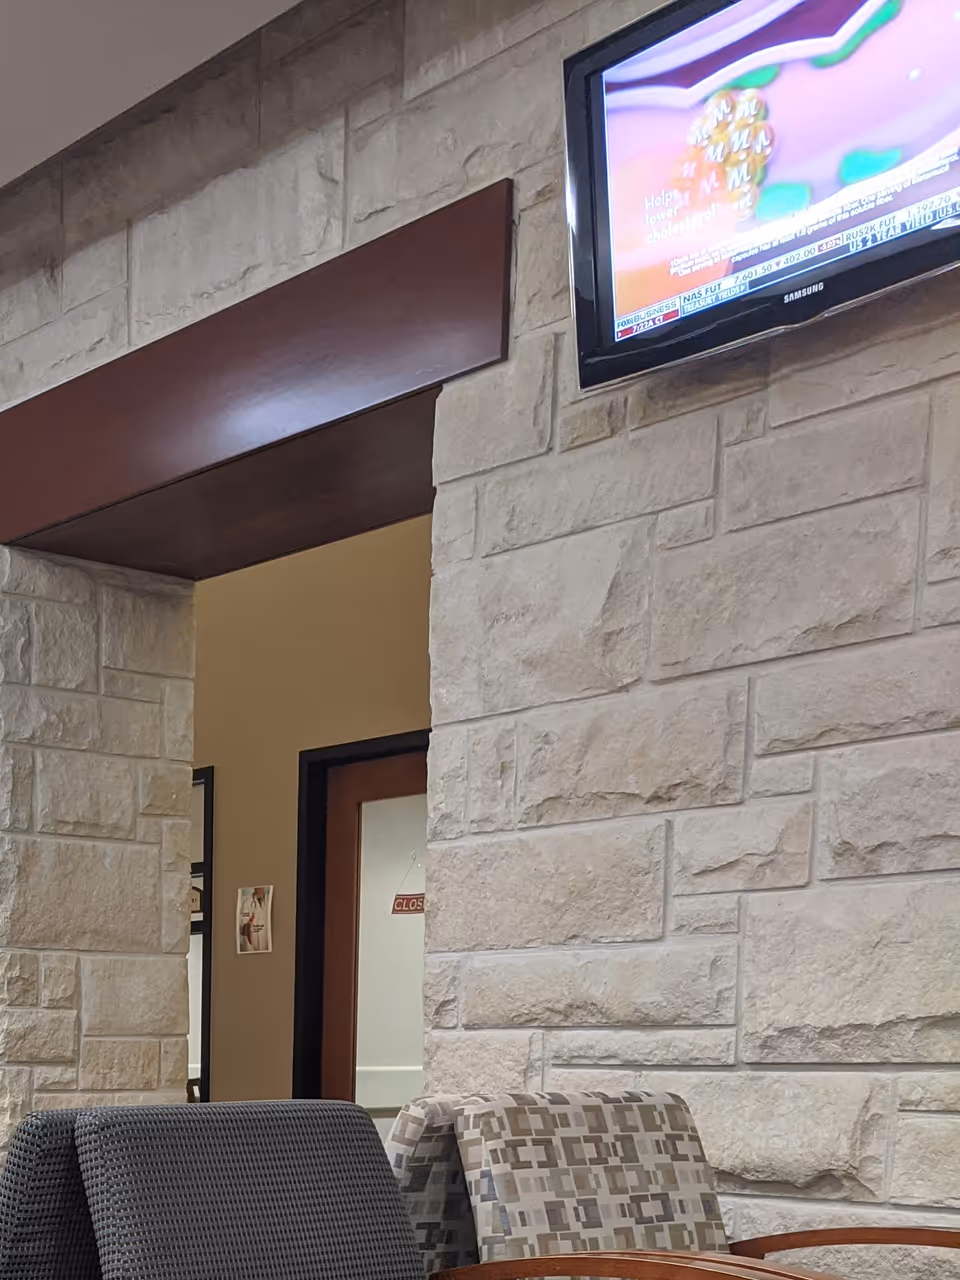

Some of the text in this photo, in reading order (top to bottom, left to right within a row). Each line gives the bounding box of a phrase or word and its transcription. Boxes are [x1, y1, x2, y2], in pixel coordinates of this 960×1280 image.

[879, 215, 897, 230] FUT
[683, 291, 702, 304] NAS
[705, 282, 722, 296] FUT
[783, 281, 824, 304] SAMSUNG
